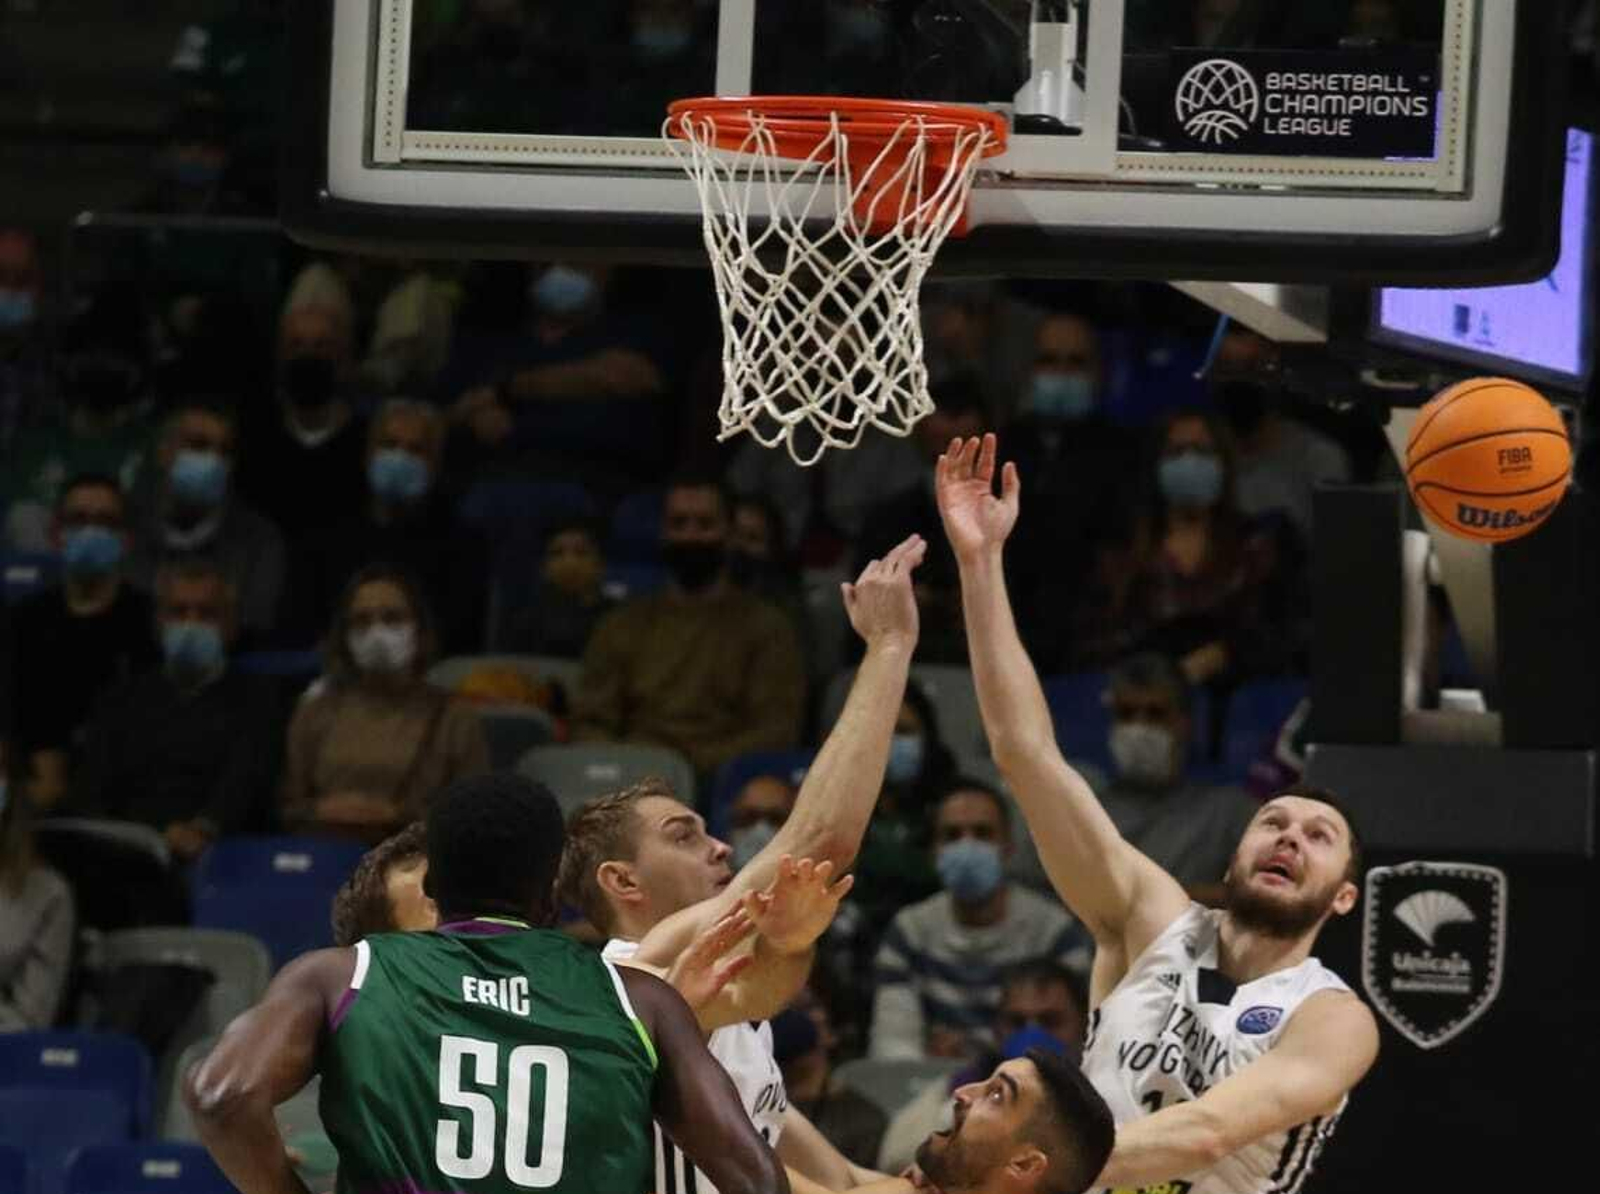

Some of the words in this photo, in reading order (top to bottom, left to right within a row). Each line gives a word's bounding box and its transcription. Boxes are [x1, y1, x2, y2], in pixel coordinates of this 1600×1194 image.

[1265, 72, 1410, 92] BASKETBALL
[1264, 93, 1428, 116] CHAMPIONS
[1263, 117, 1351, 135] LEAGUE
[1497, 447, 1532, 466] FIBA
[462, 975, 530, 1016] ERIC
[435, 1034, 569, 1188] 50
